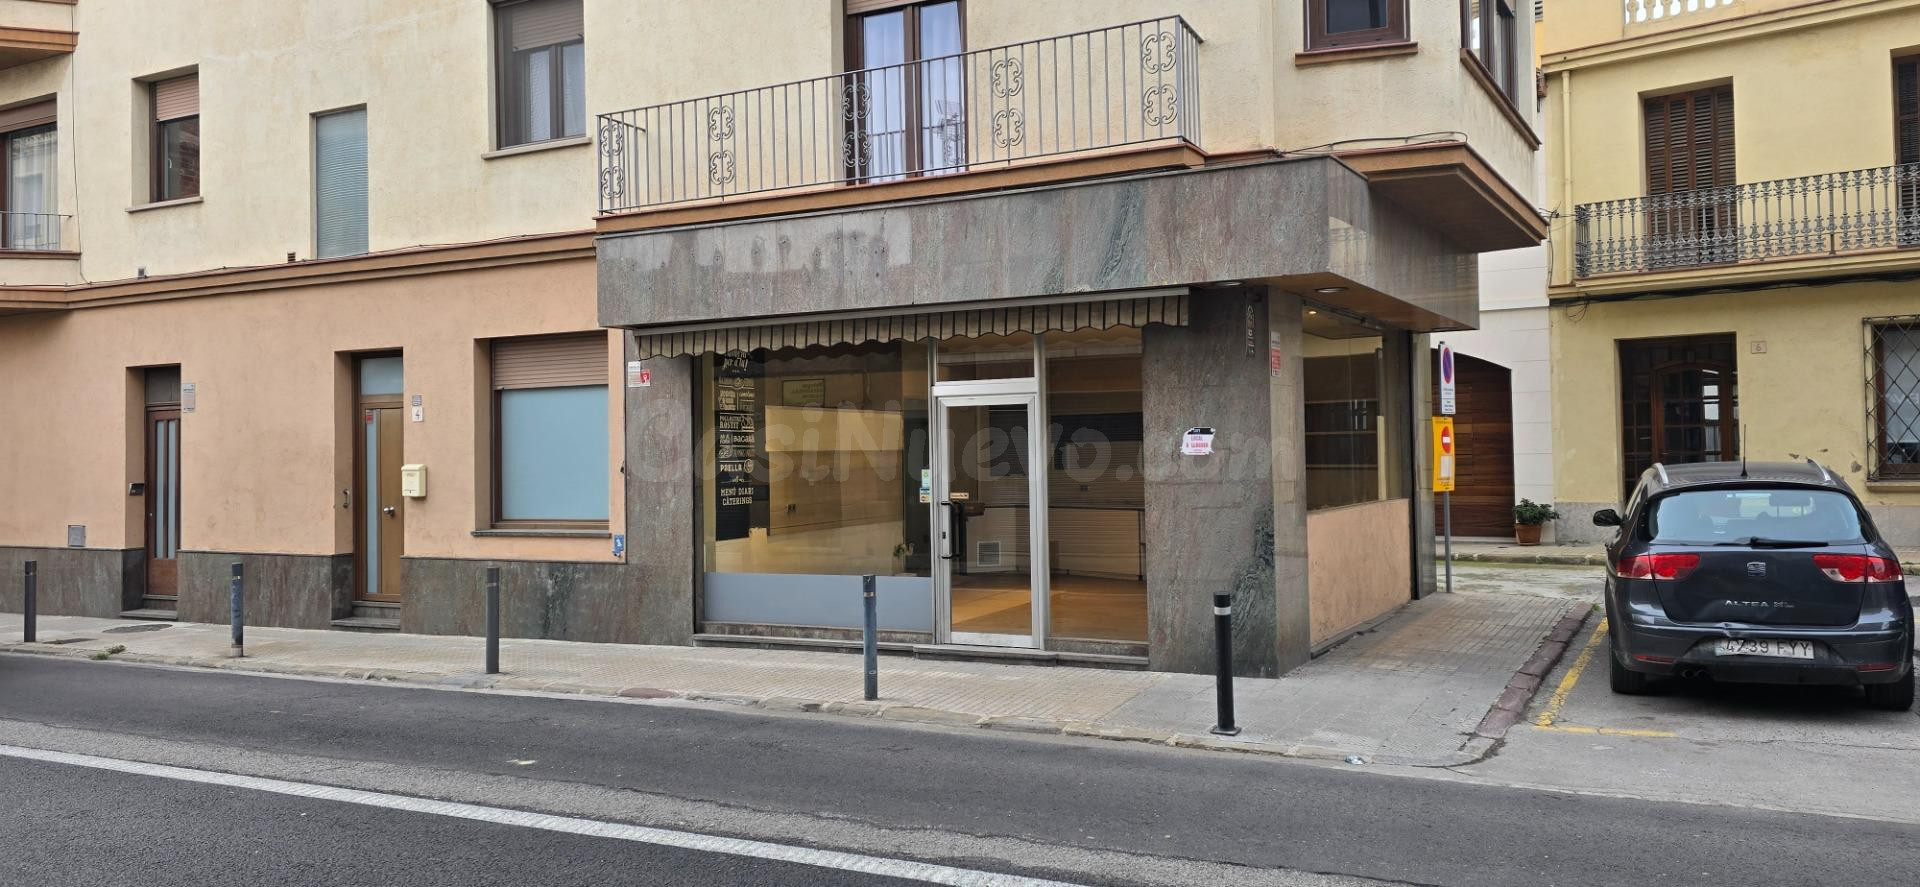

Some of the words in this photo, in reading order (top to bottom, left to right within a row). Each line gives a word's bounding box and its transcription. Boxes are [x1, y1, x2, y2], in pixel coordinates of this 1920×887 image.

[415, 408, 421, 420] 4
[1725, 600, 1769, 608] ALTEA
[1776, 639, 1811, 657] FYY
